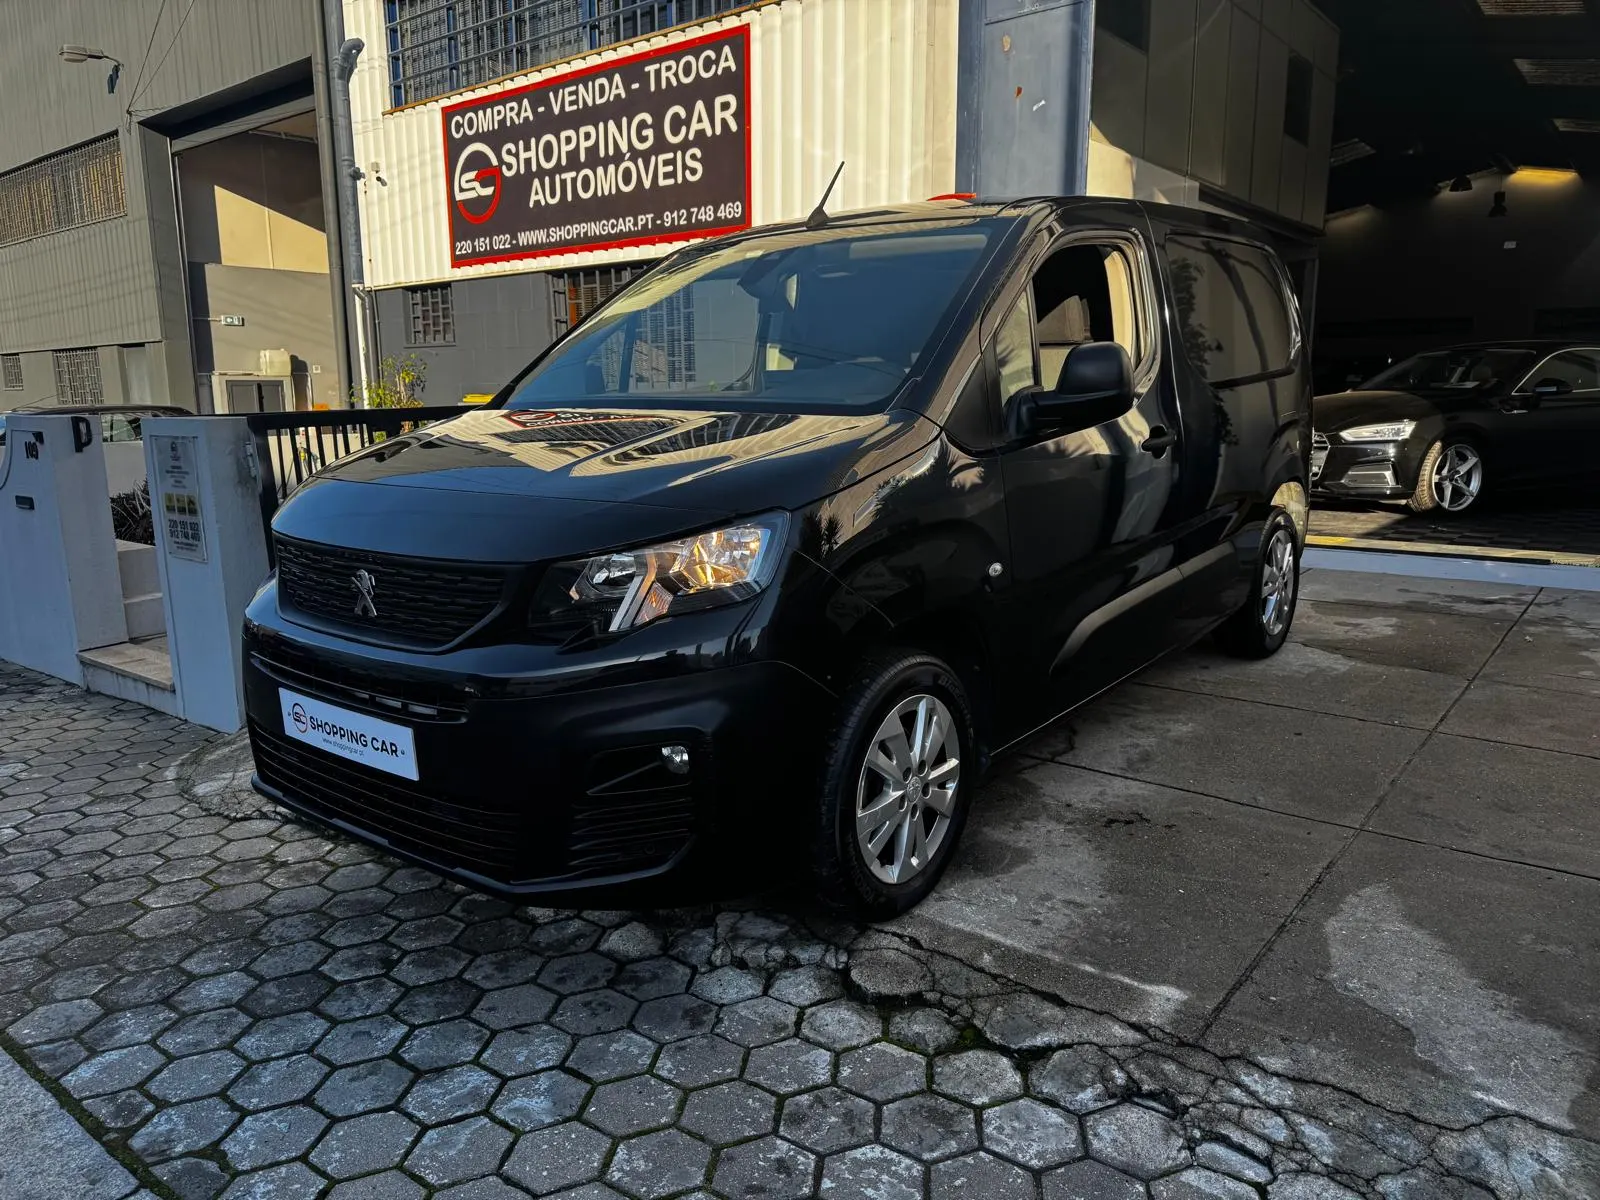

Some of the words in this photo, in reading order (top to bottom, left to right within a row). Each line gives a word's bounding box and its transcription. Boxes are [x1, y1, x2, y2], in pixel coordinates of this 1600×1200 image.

[451, 98, 534, 139] COMPRA
[549, 73, 626, 116] VENDA
[631, 82, 640, 90] -
[644, 45, 736, 92] TROCA
[501, 111, 654, 177] SHOPPING
[664, 94, 738, 144] CAR
[529, 147, 703, 208] AUTOMÓVEIS
[455, 240, 472, 255] 220
[474, 236, 490, 253] 151
[492, 234, 511, 251] 022
[518, 214, 654, 247] WWW.SHOPPINGCAR.PT
[663, 209, 687, 227] 912
[690, 205, 714, 223] 748
[717, 200, 742, 220] 469
[71, 416, 93, 453] P
[309, 715, 368, 748] SHOPPING
[371, 736, 400, 758] CAR
